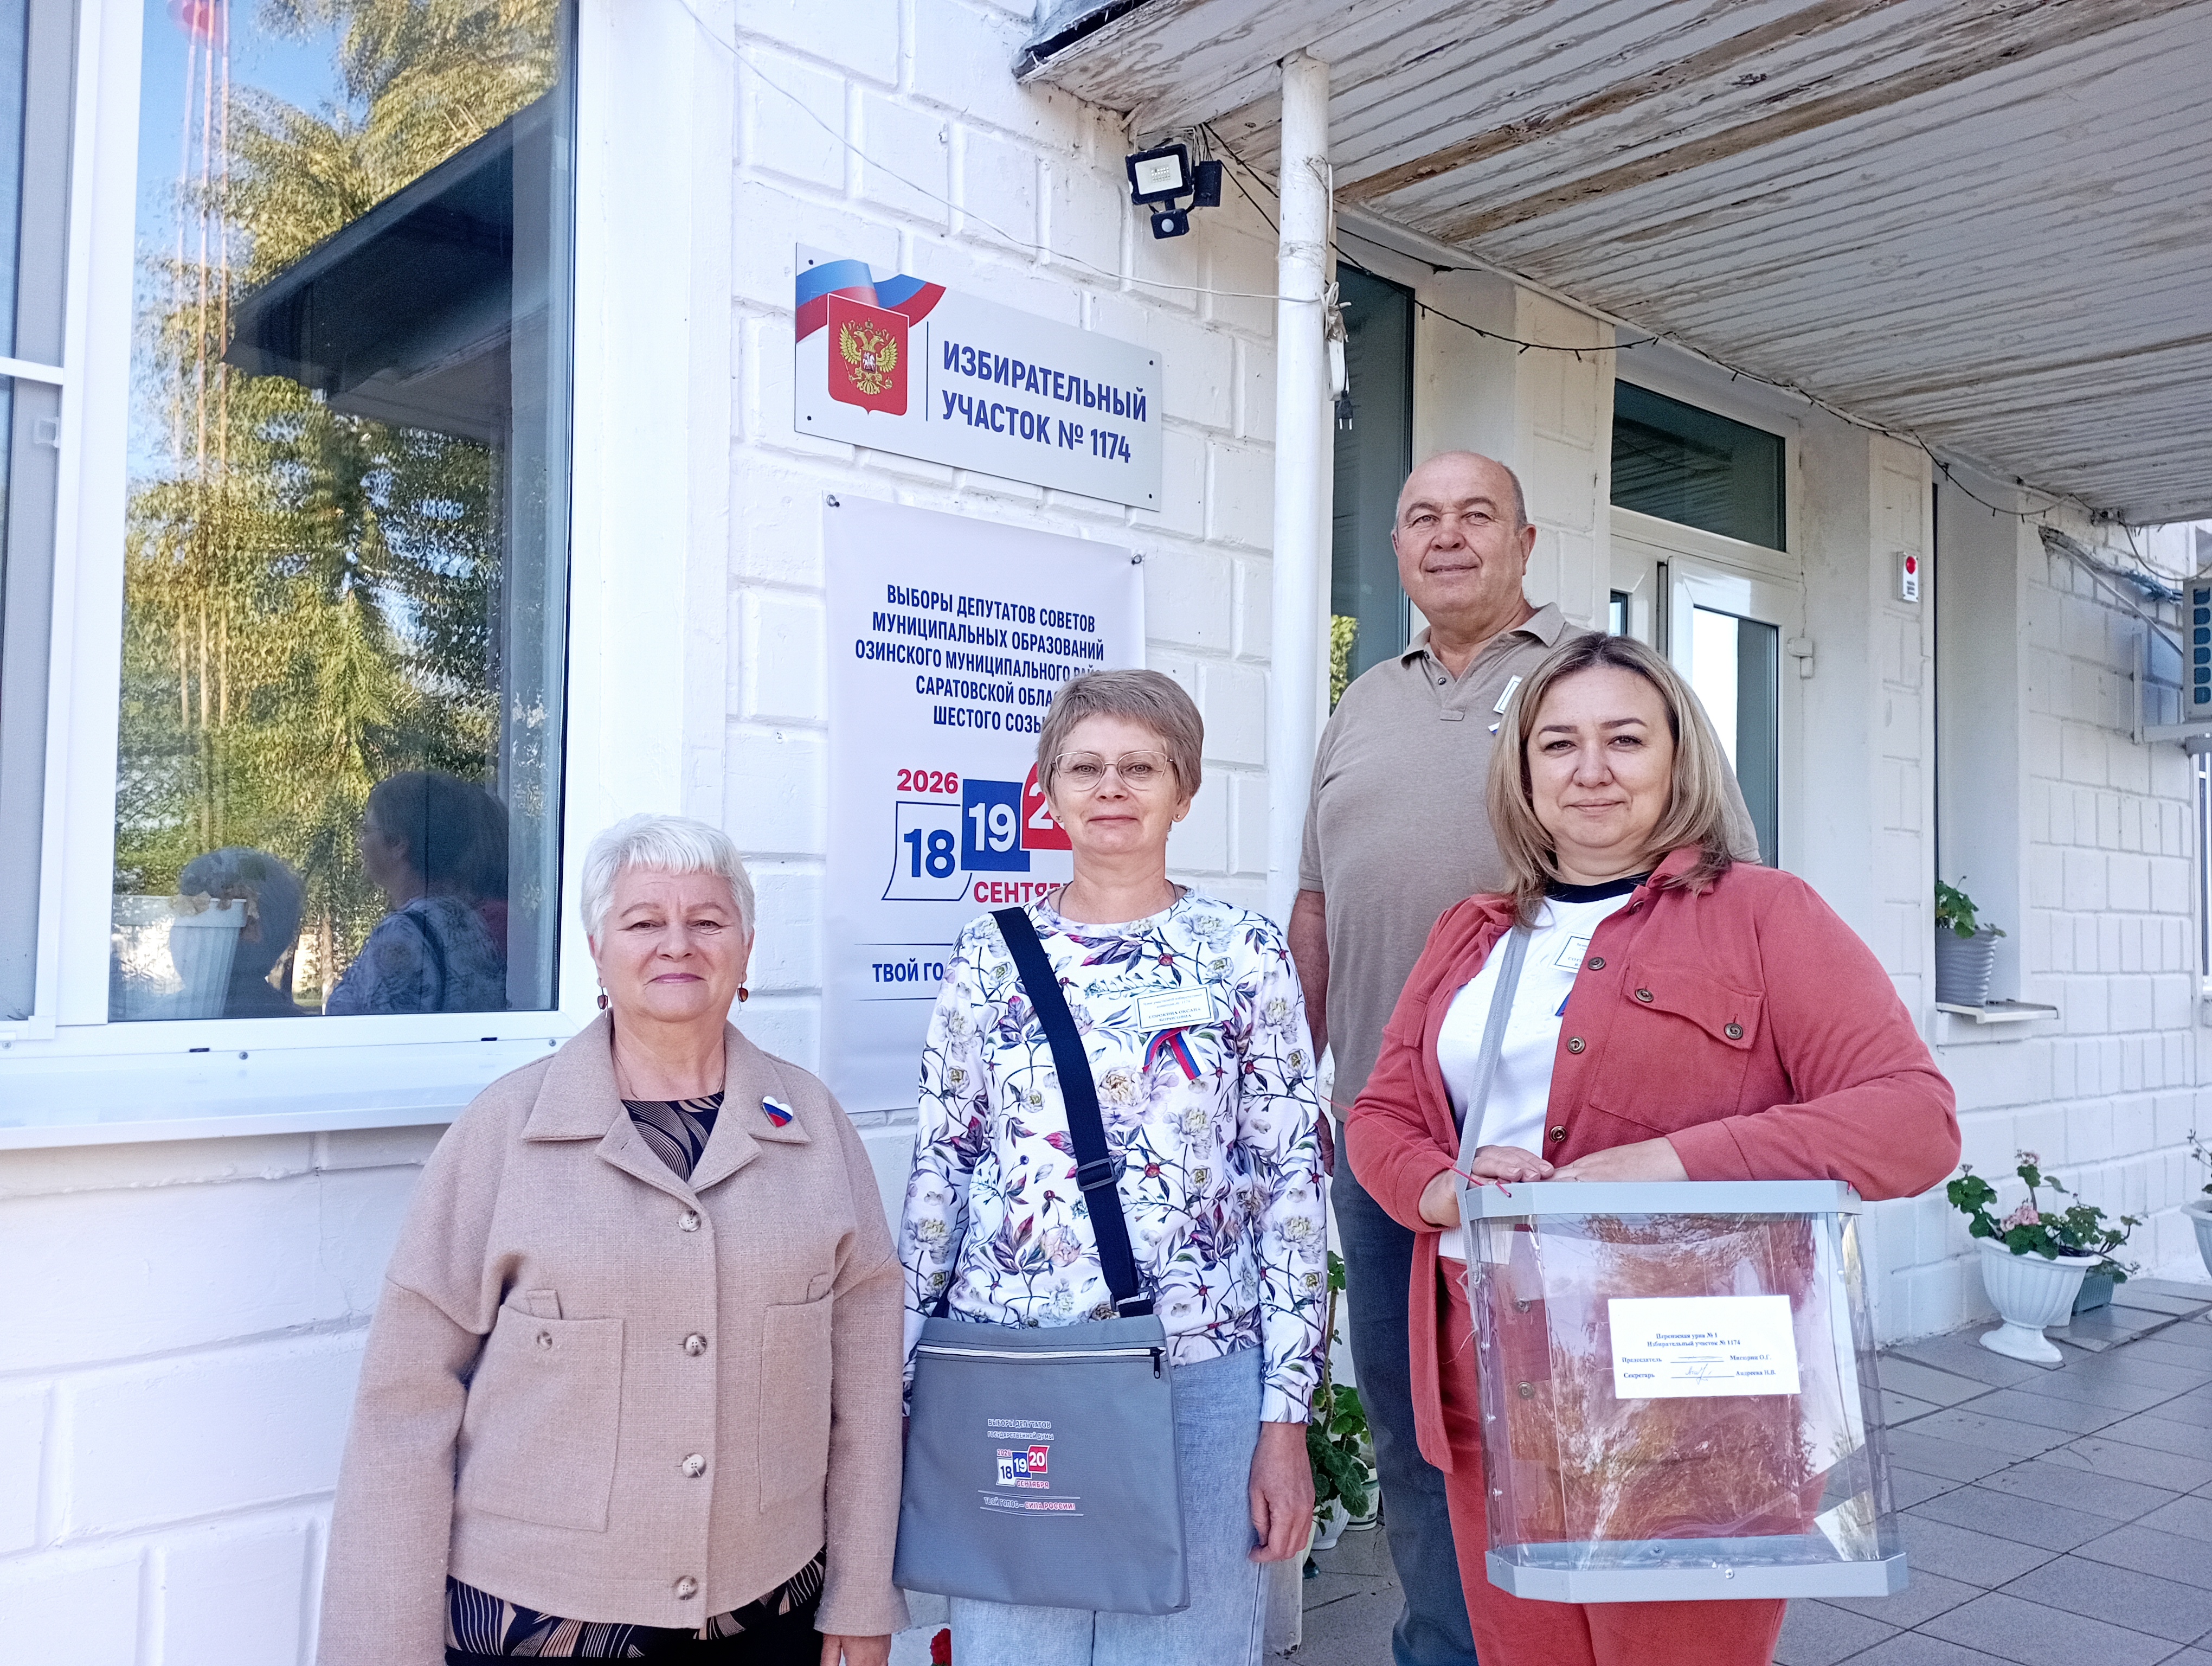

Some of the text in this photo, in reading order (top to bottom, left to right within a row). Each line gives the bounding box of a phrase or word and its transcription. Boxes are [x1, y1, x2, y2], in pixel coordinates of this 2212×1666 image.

[944, 341, 1147, 422] ИЗБИРАТЕЛЬНЫЙ
[942, 390, 1130, 464] УЧАСТОК № 1174
[887, 584, 1095, 633] ВЫБОРЫ ДЕПУТАТОВ СОВЕТОВ
[872, 611, 1104, 661] МУНИЦИПАЛЬНЫХ ОБРАЗОВАНИЙ
[856, 639, 941, 667] ОЗИНСКОГО
[946, 650, 1070, 682] МУНИЦИПАЛЬНОГО
[916, 676, 1058, 707] САРАТОВСКОЙ ОБЛА
[934, 706, 1045, 734] ШЕСТОГО СОЗЫ
[897, 768, 959, 794] 2026
[904, 781, 1054, 879] 18 19 2
[974, 881, 1068, 903] СЕНТЯ
[872, 957, 944, 983] ТВОЙ ГО
[987, 1419, 1051, 1429] ВЫБОРЫ ДЕПУТАТОВ
[997, 1449, 1011, 1457] 2026
[1000, 1452, 1045, 1479] 18 19 20
[1016, 1479, 1050, 1489] СЕНТЯБРЯ
[1024, 1501, 1044, 1510] СИЛА
